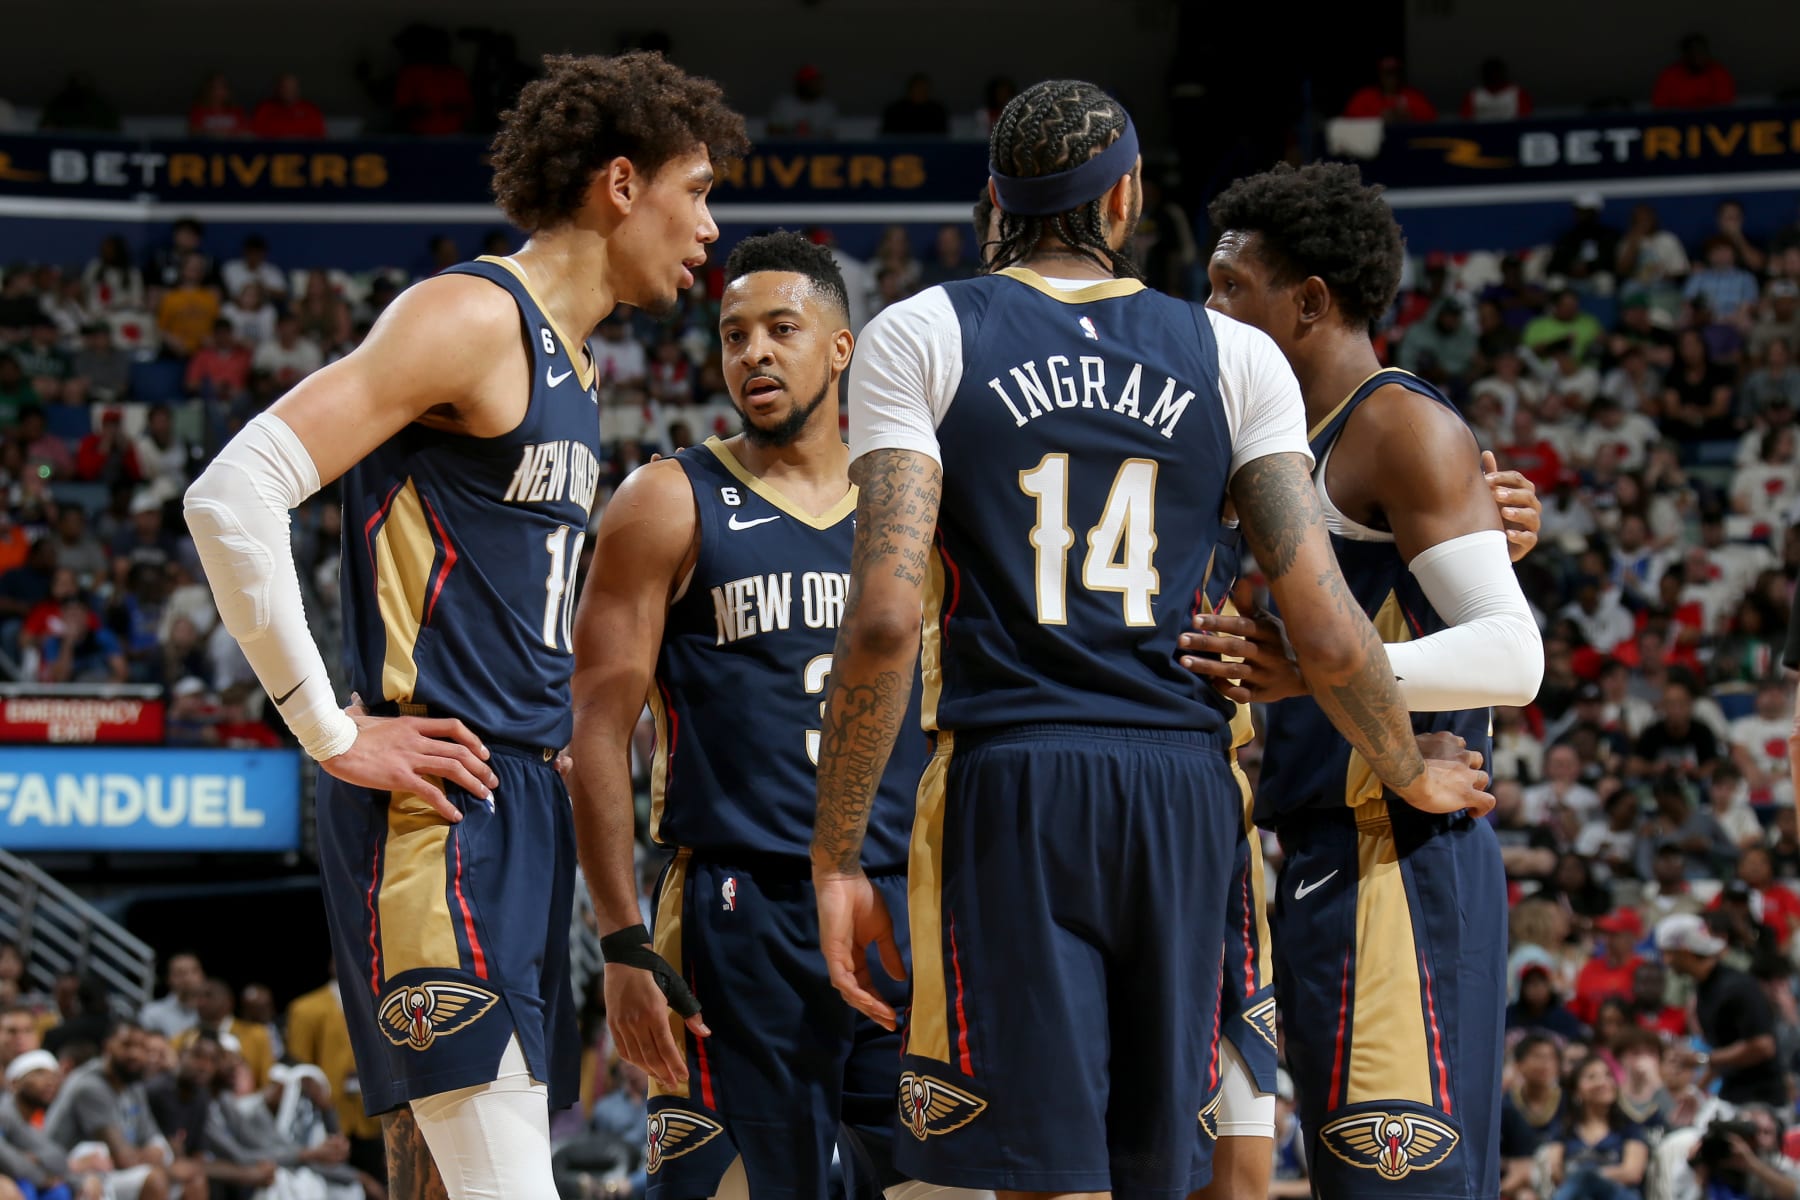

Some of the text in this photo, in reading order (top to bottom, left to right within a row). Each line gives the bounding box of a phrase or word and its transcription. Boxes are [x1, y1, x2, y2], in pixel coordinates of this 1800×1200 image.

[1519, 119, 1800, 168] BETRIVE
[50, 149, 389, 188] BETRIVERS
[540, 327, 556, 355] 6
[987, 354, 1197, 440] INGRAM
[503, 440, 570, 502] NEW
[720, 486, 742, 506] 6
[1018, 452, 1160, 627] 14
[711, 571, 851, 647] NEW OR
[4, 699, 143, 724] EMERGENCY
[47, 720, 99, 743] EXIT
